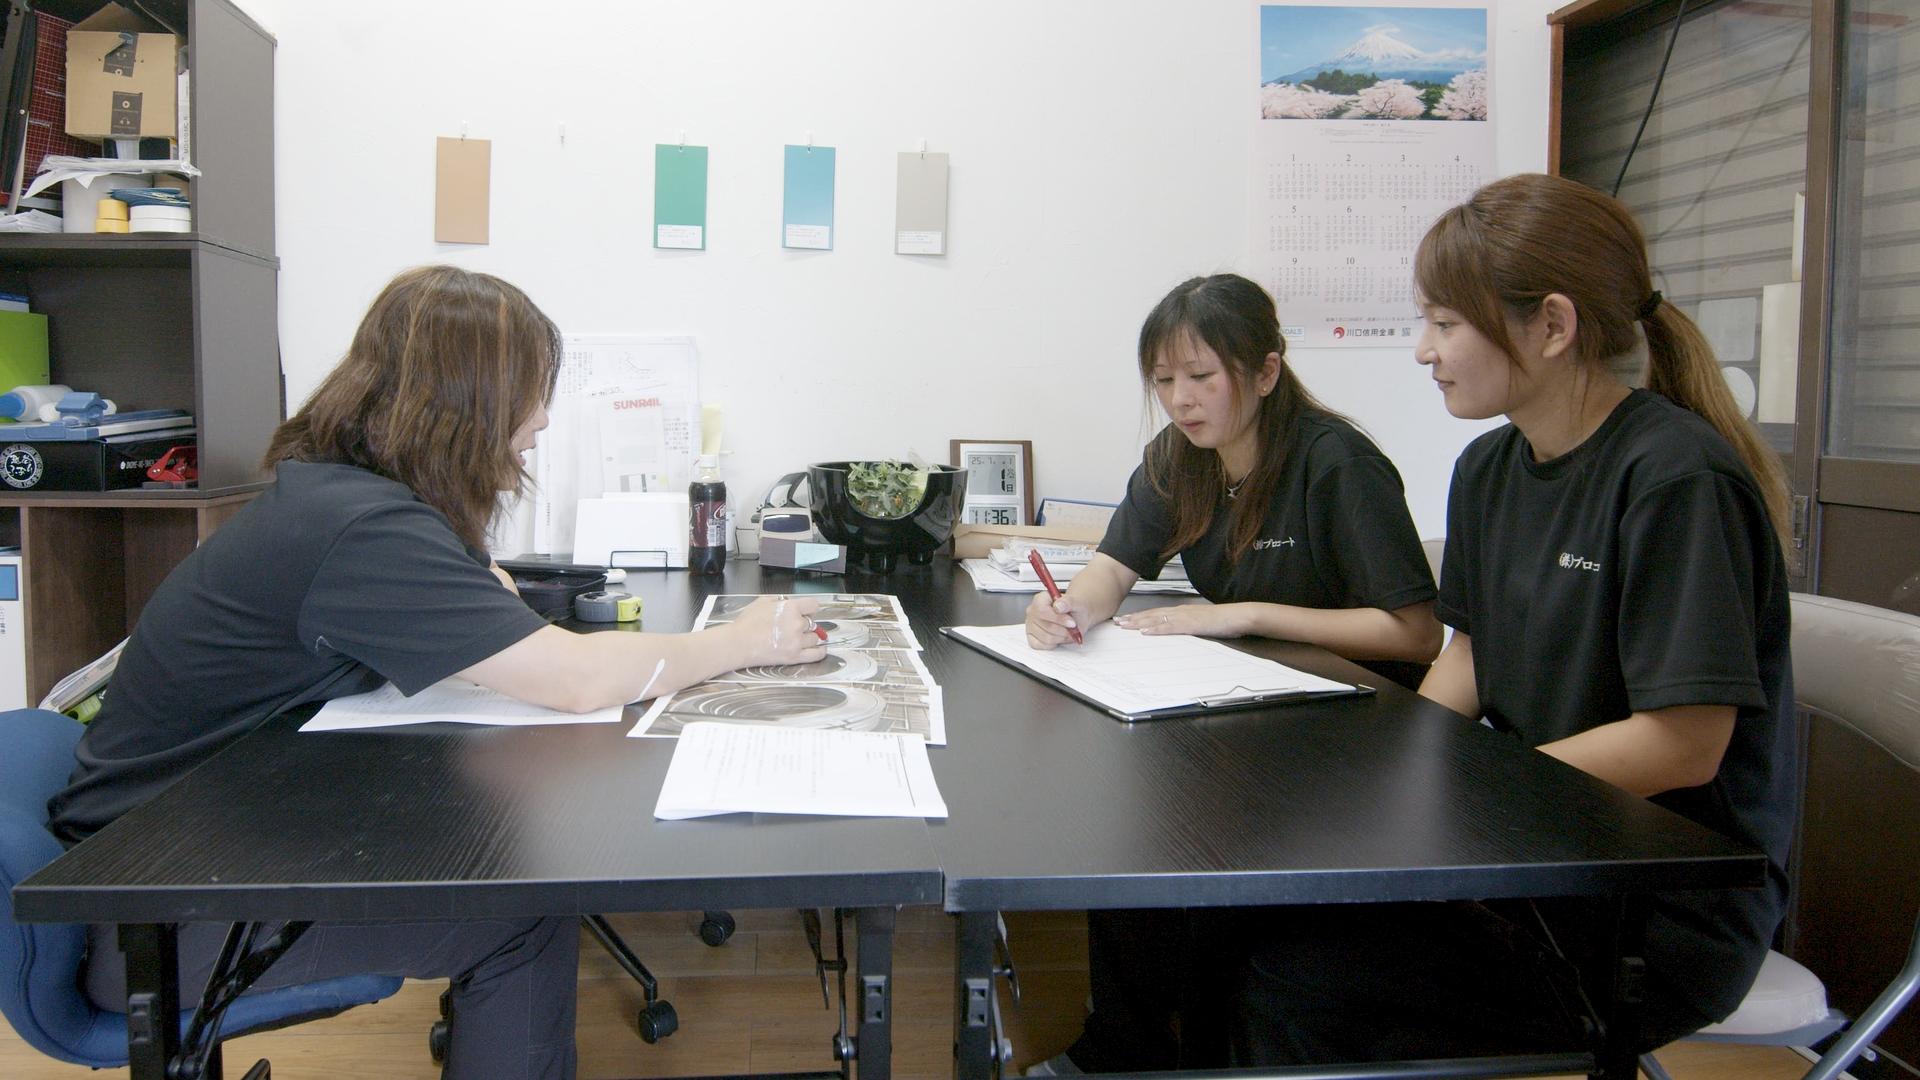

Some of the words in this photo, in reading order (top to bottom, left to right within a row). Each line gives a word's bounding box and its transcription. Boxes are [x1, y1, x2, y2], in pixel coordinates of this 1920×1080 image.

[1346, 153, 1352, 162] 2
[1454, 154, 1460, 162] 4
[1346, 206, 1352, 214] 6
[1292, 257, 1298, 265] 9
[1346, 257, 1355, 265] 10
[1400, 257, 1409, 265] 11
[1346, 327, 1396, 337] 川口信用金庫
[975, 509, 1010, 525] 11:36
